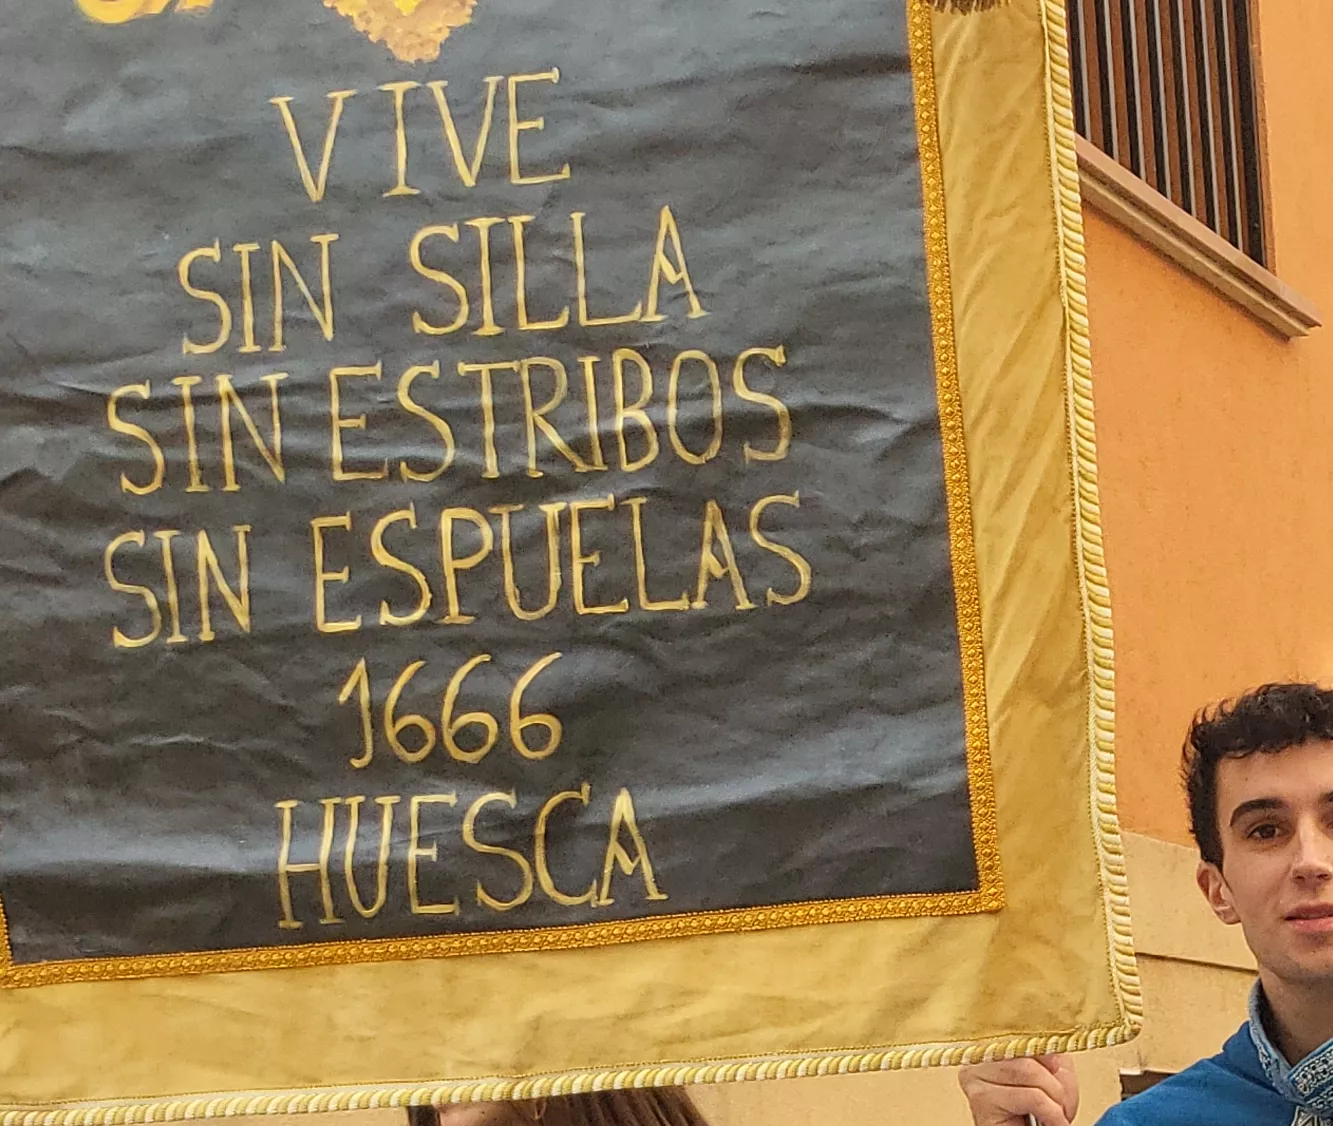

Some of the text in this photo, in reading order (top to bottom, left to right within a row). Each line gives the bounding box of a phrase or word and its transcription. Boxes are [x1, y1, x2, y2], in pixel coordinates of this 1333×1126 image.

[272, 67, 571, 201] VIVE
[178, 206, 710, 355] SIN SILLA
[106, 347, 793, 497] SIN ESTRIBOS
[104, 491, 813, 649] SIN ESPUELAS
[339, 652, 563, 768] 1666
[276, 782, 669, 930] HUESCA
